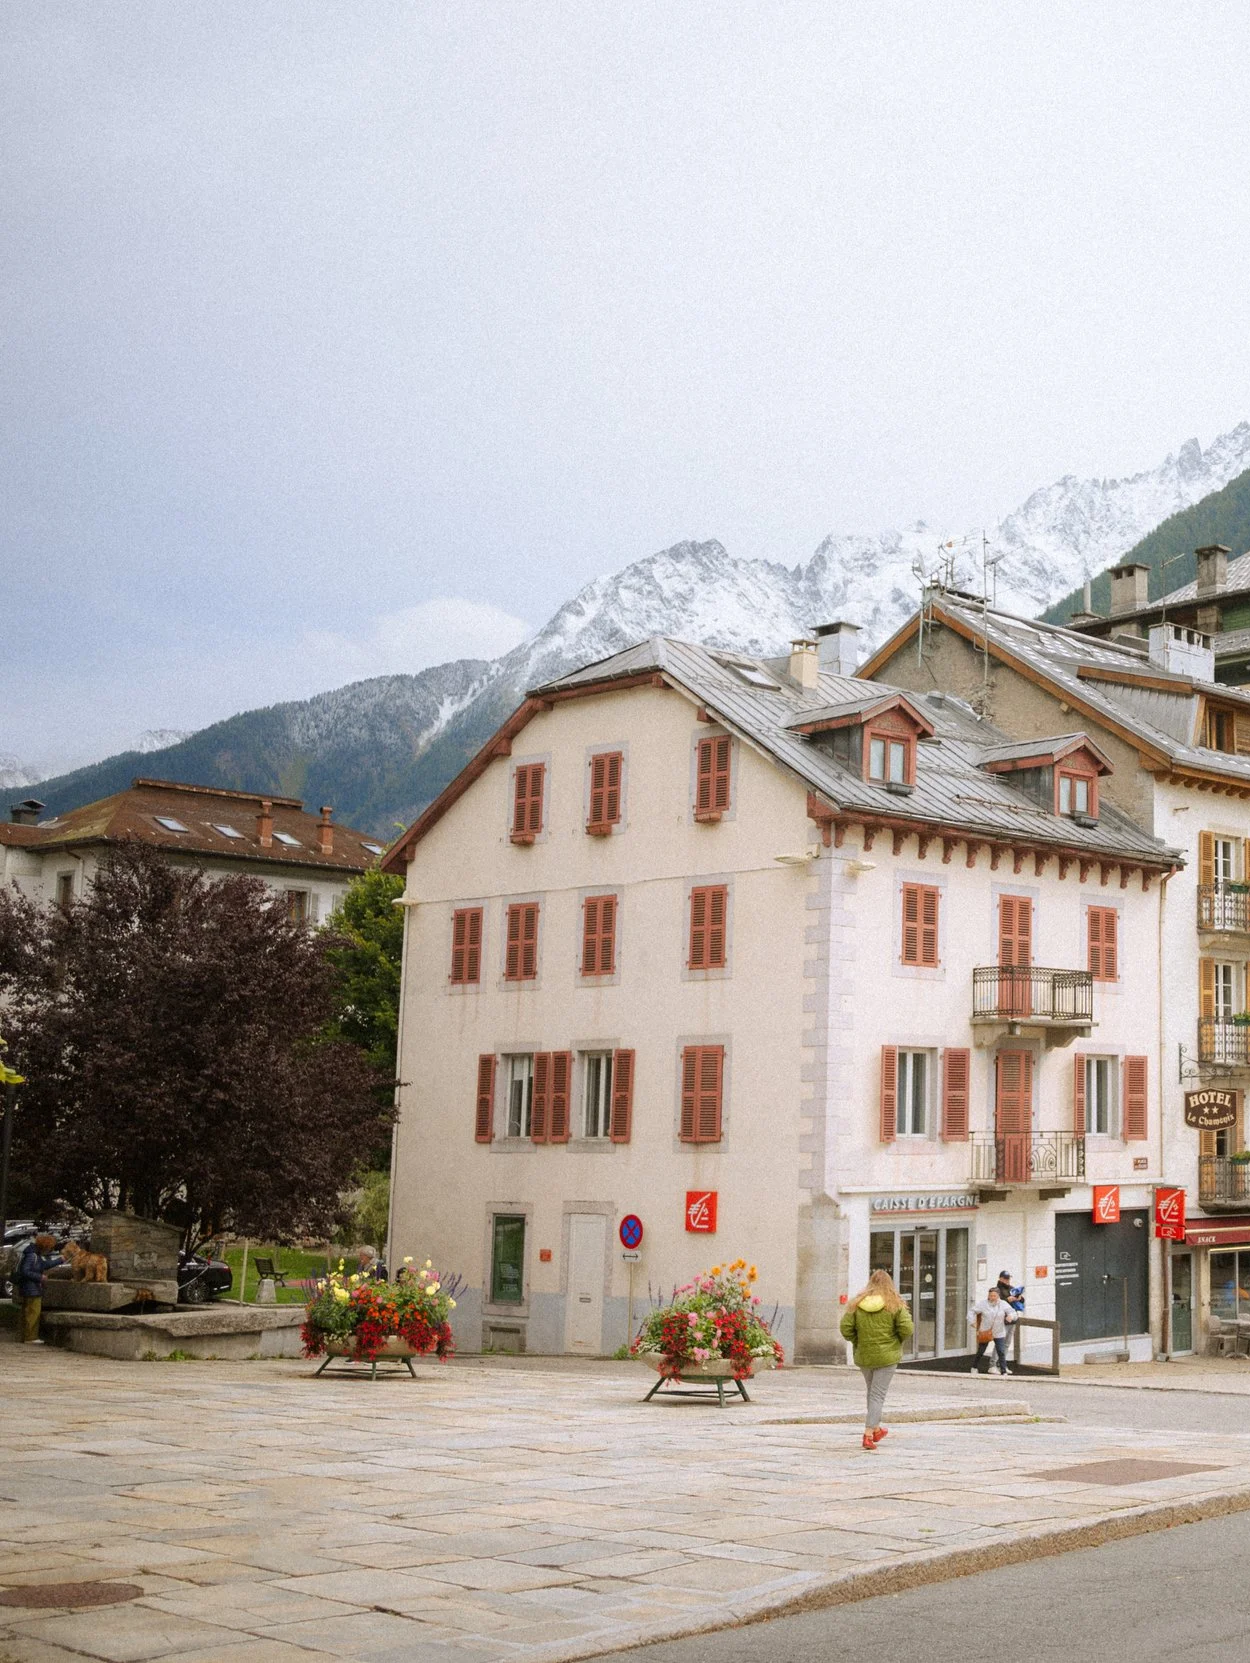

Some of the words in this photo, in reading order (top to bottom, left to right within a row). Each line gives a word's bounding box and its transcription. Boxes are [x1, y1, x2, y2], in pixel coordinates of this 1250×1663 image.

[1189, 1091, 1231, 1108] HOTEL
[1187, 1112, 1197, 1122] Le
[1198, 1113, 1235, 1126] Chamonix
[874, 1197, 913, 1210] CAISSE
[1198, 1235, 1216, 1244] SNACK
